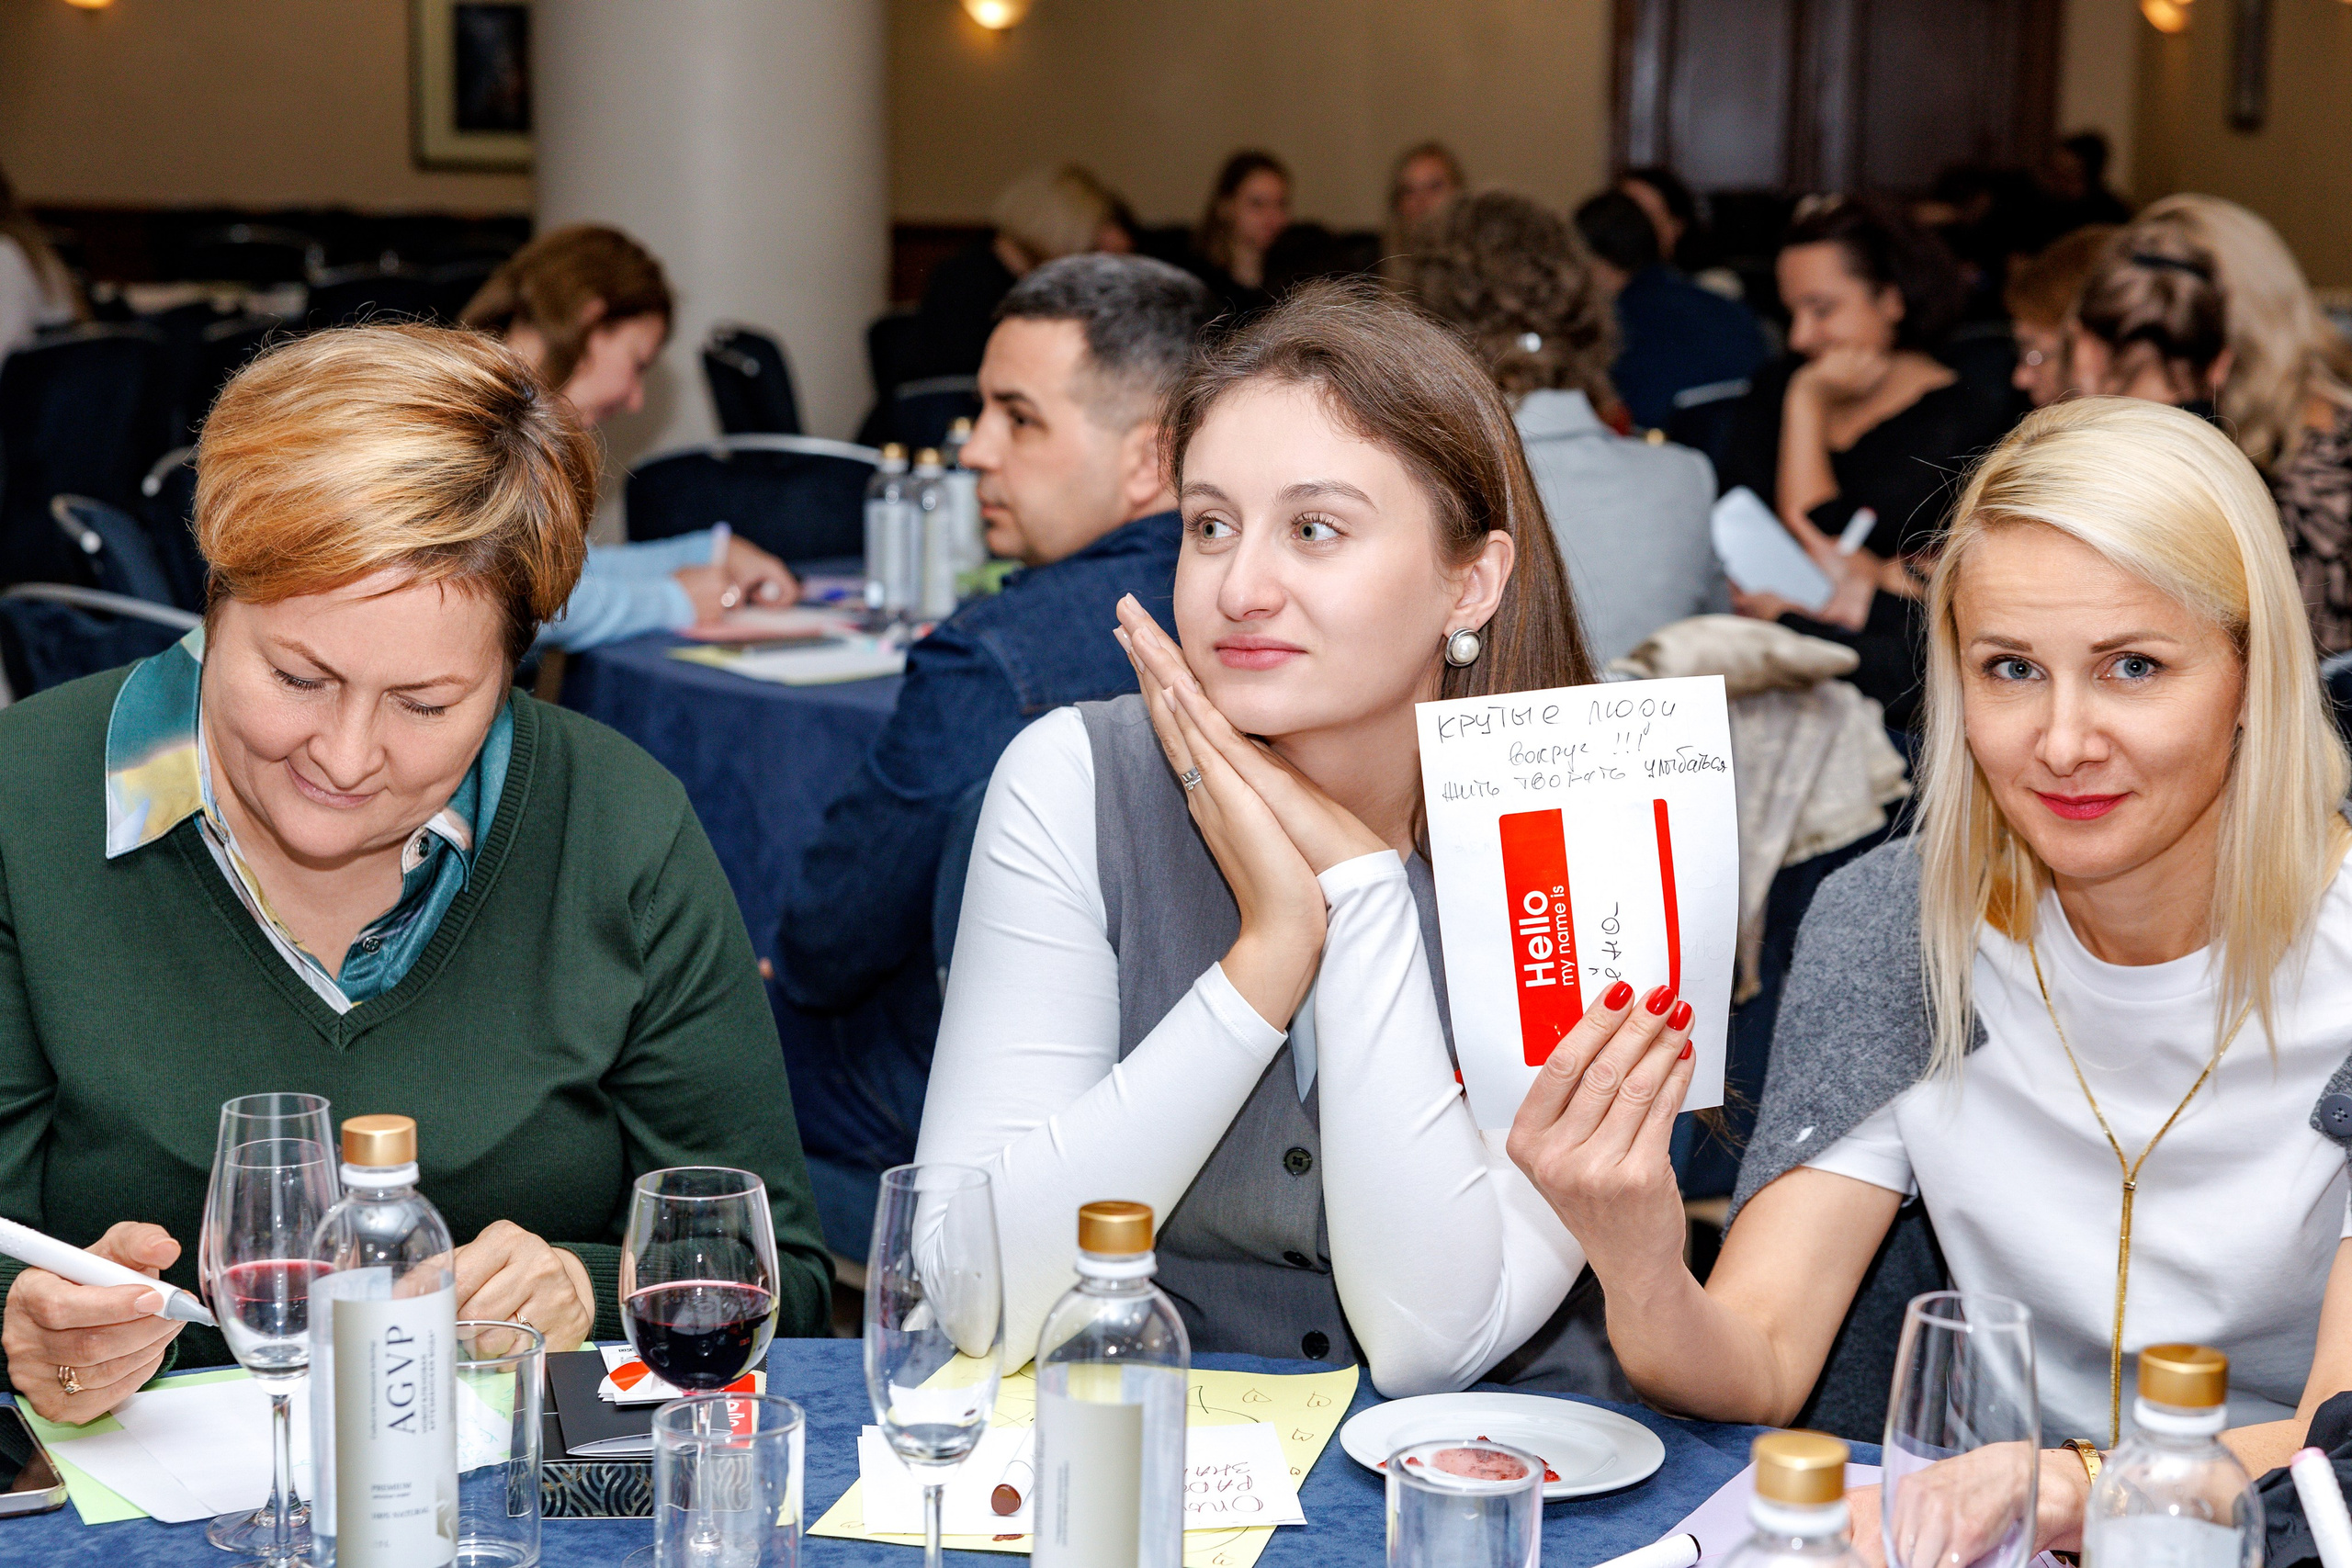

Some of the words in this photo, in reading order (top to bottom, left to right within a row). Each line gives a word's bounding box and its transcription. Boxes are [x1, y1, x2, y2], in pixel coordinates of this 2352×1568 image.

[1644, 745, 1728, 779] улыбаться
[1550, 885, 1566, 898] is
[1518, 889, 1556, 988] Hello
[1553, 901, 1571, 954] name
[1559, 958, 1576, 987] my
[385, 1325, 417, 1435] AGVP
